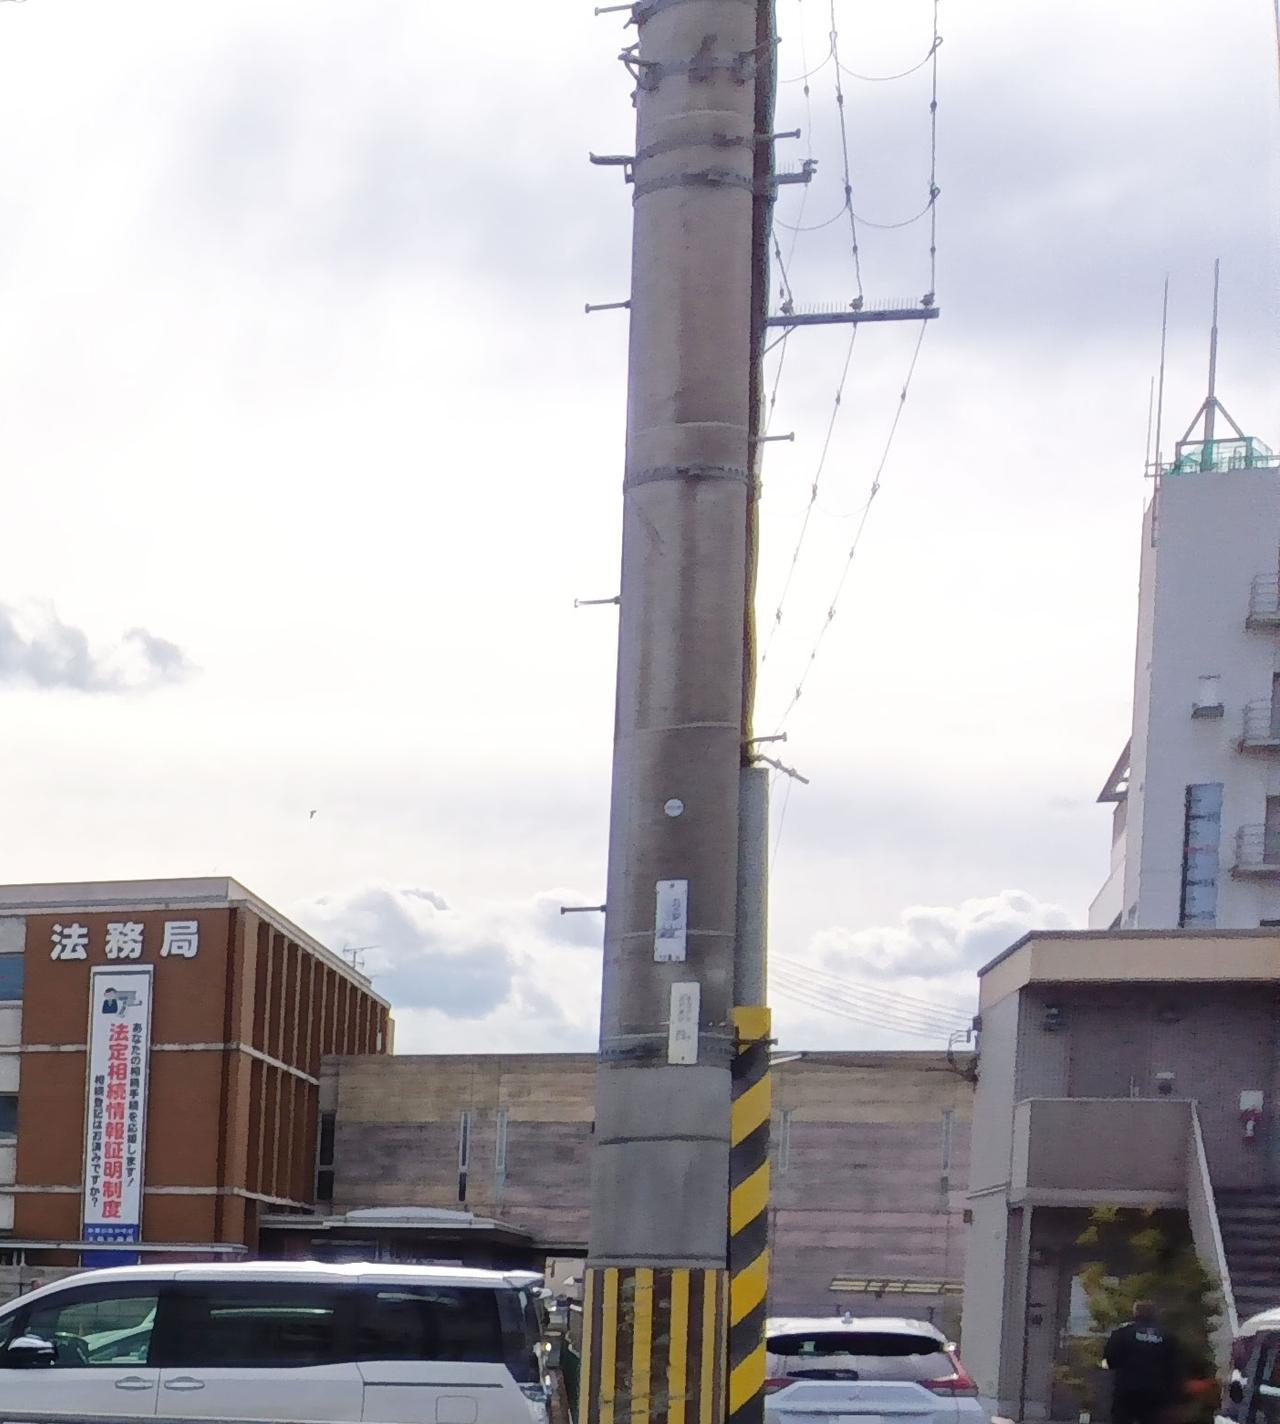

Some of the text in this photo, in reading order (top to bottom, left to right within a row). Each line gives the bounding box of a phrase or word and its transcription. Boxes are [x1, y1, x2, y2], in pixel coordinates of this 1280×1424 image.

[50, 921, 199, 961] 法務局
[101, 1023, 130, 1219] 法定相続情報証明制度
